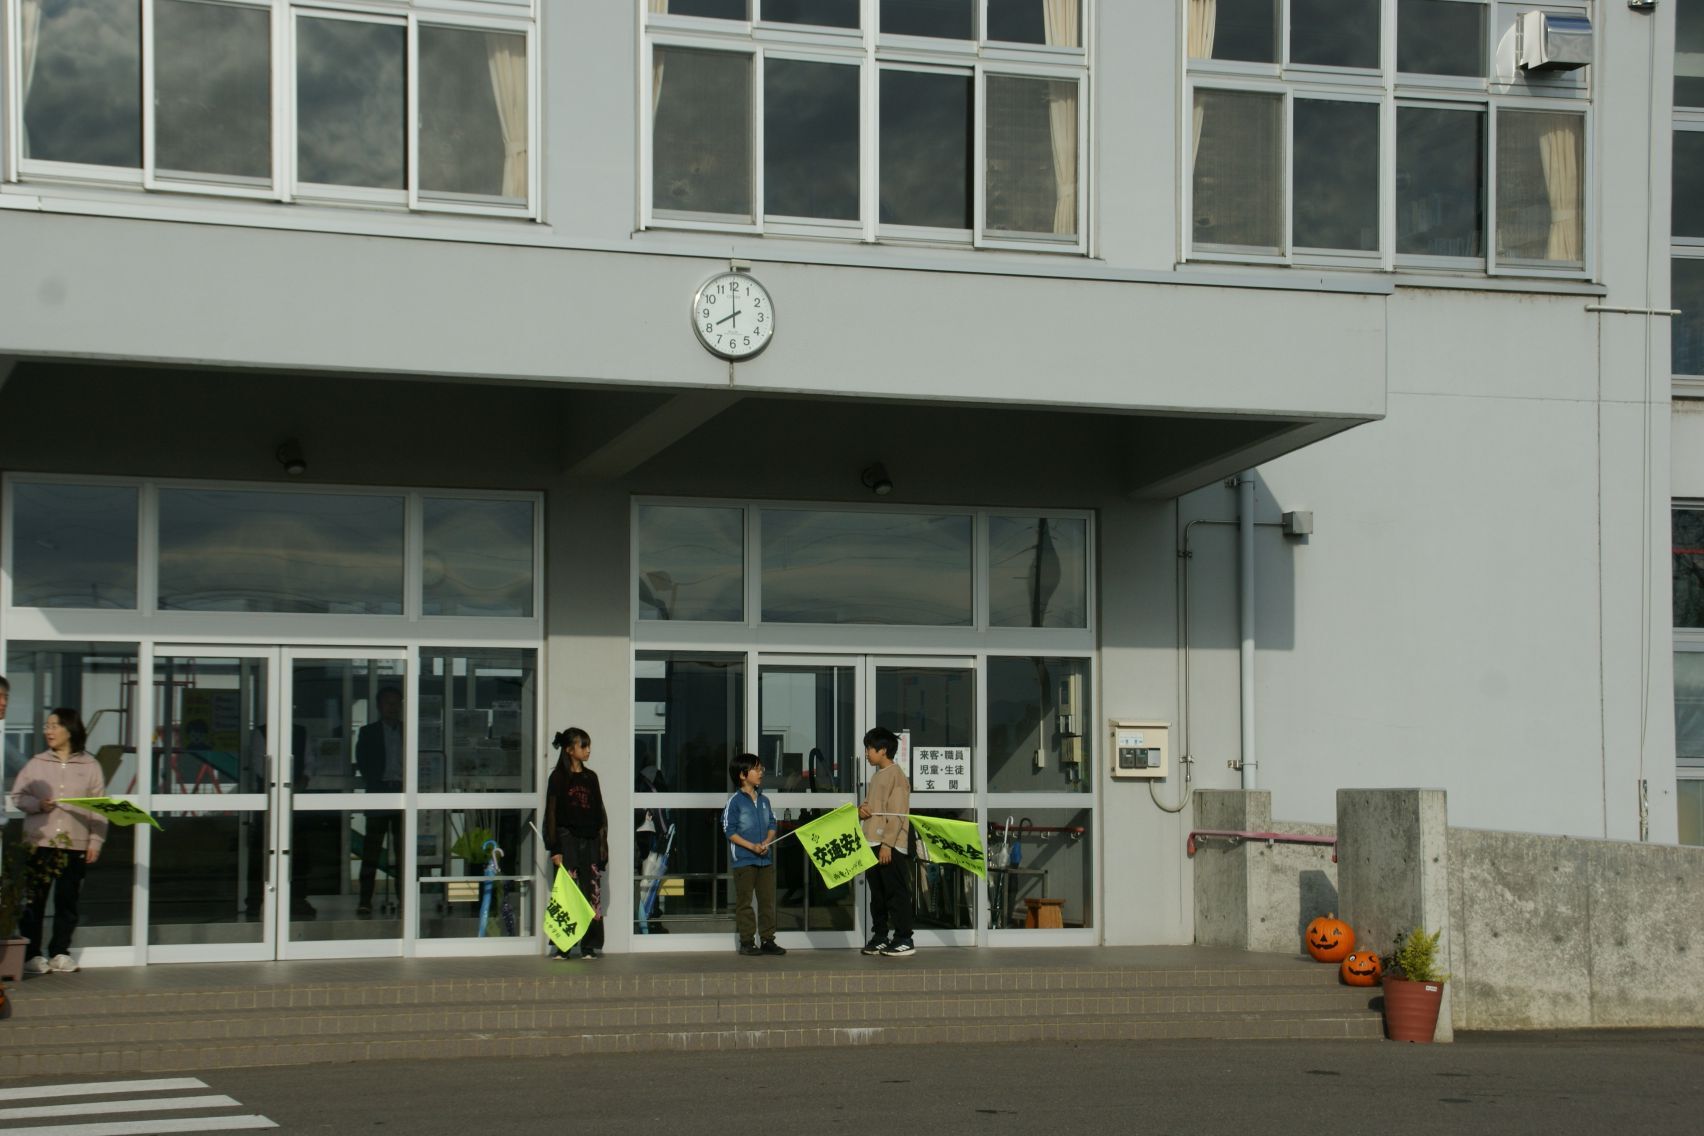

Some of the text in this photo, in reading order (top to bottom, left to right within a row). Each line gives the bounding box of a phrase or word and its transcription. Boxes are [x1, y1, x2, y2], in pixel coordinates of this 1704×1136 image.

[717, 285, 725, 295] 11
[729, 281, 739, 292] 12
[705, 294, 716, 304] 10
[754, 298, 761, 308] 2
[702, 308, 710, 318] 9
[757, 312, 764, 323] 3
[706, 323, 713, 333] 8
[753, 326, 760, 336] 4
[716, 334, 723, 344] 7
[729, 339, 736, 349] 6
[743, 336, 750, 346] 5
[920, 750, 964, 760] 来客・職員
[920, 764, 964, 775] 児童・生徒
[547, 897, 577, 937] 通安全
